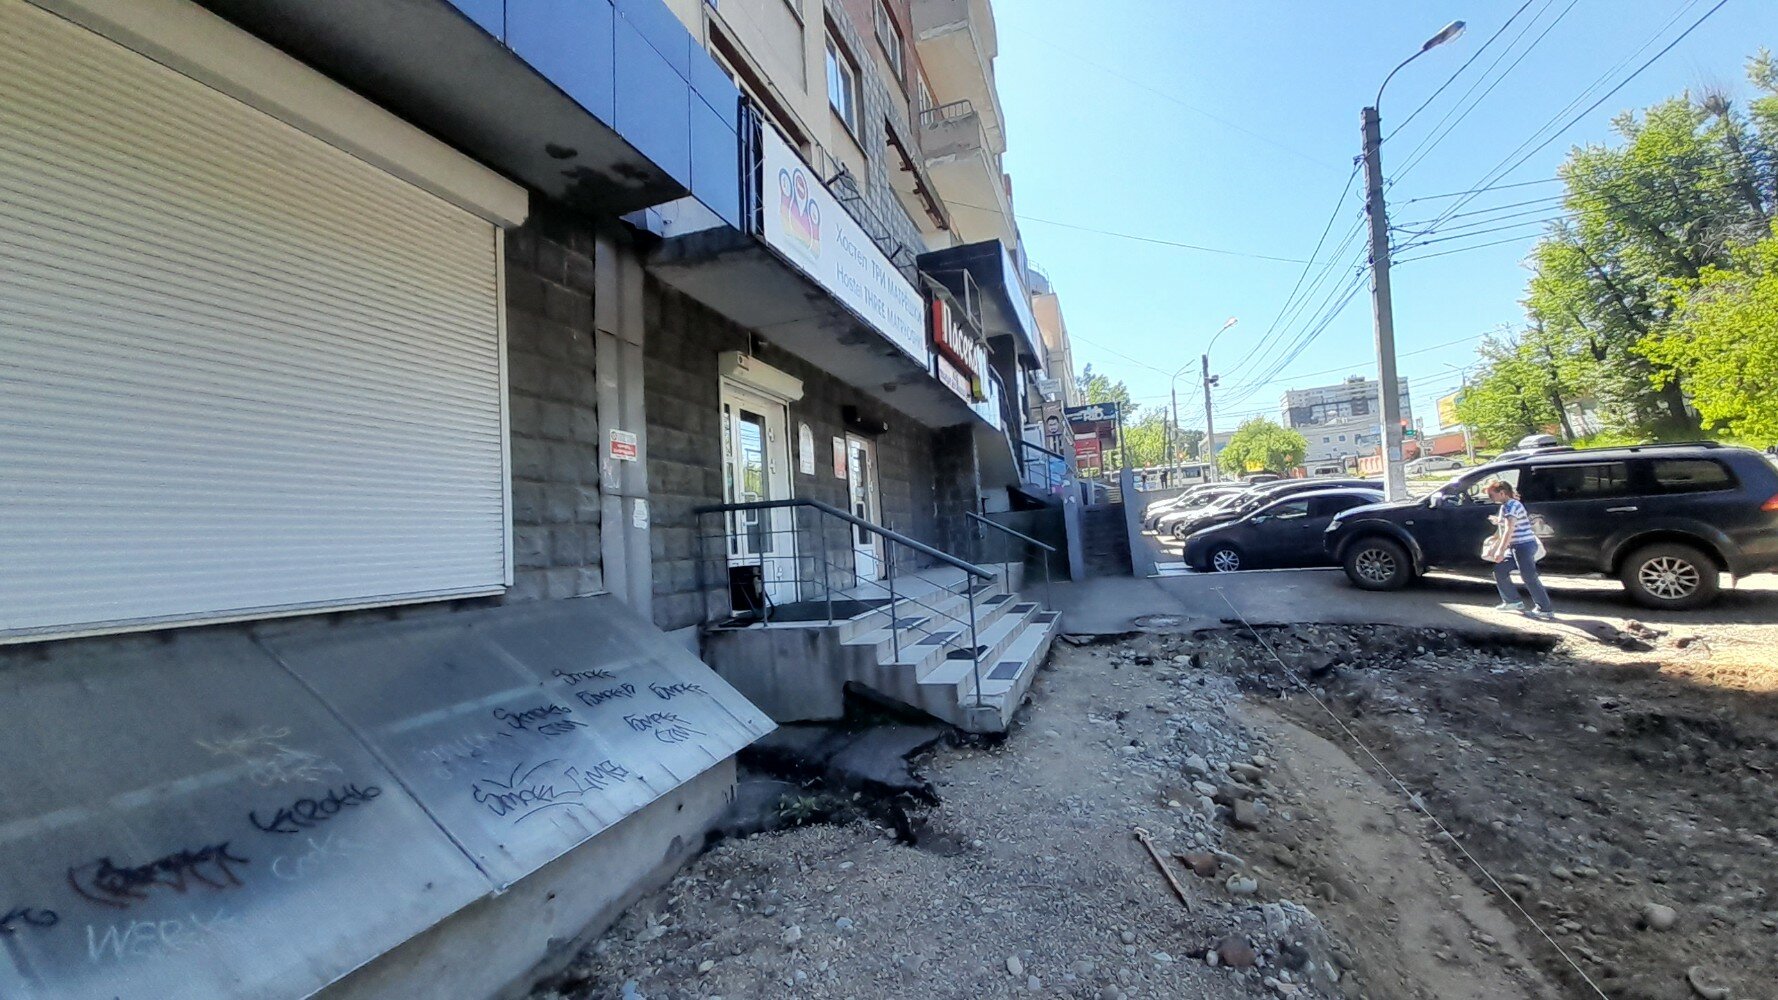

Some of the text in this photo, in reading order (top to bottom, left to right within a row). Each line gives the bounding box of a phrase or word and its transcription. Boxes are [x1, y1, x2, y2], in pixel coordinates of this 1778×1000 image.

[836, 223, 868, 270] Хостел
[871, 260, 887, 290] ТРИ
[836, 262, 863, 298] Hostel
